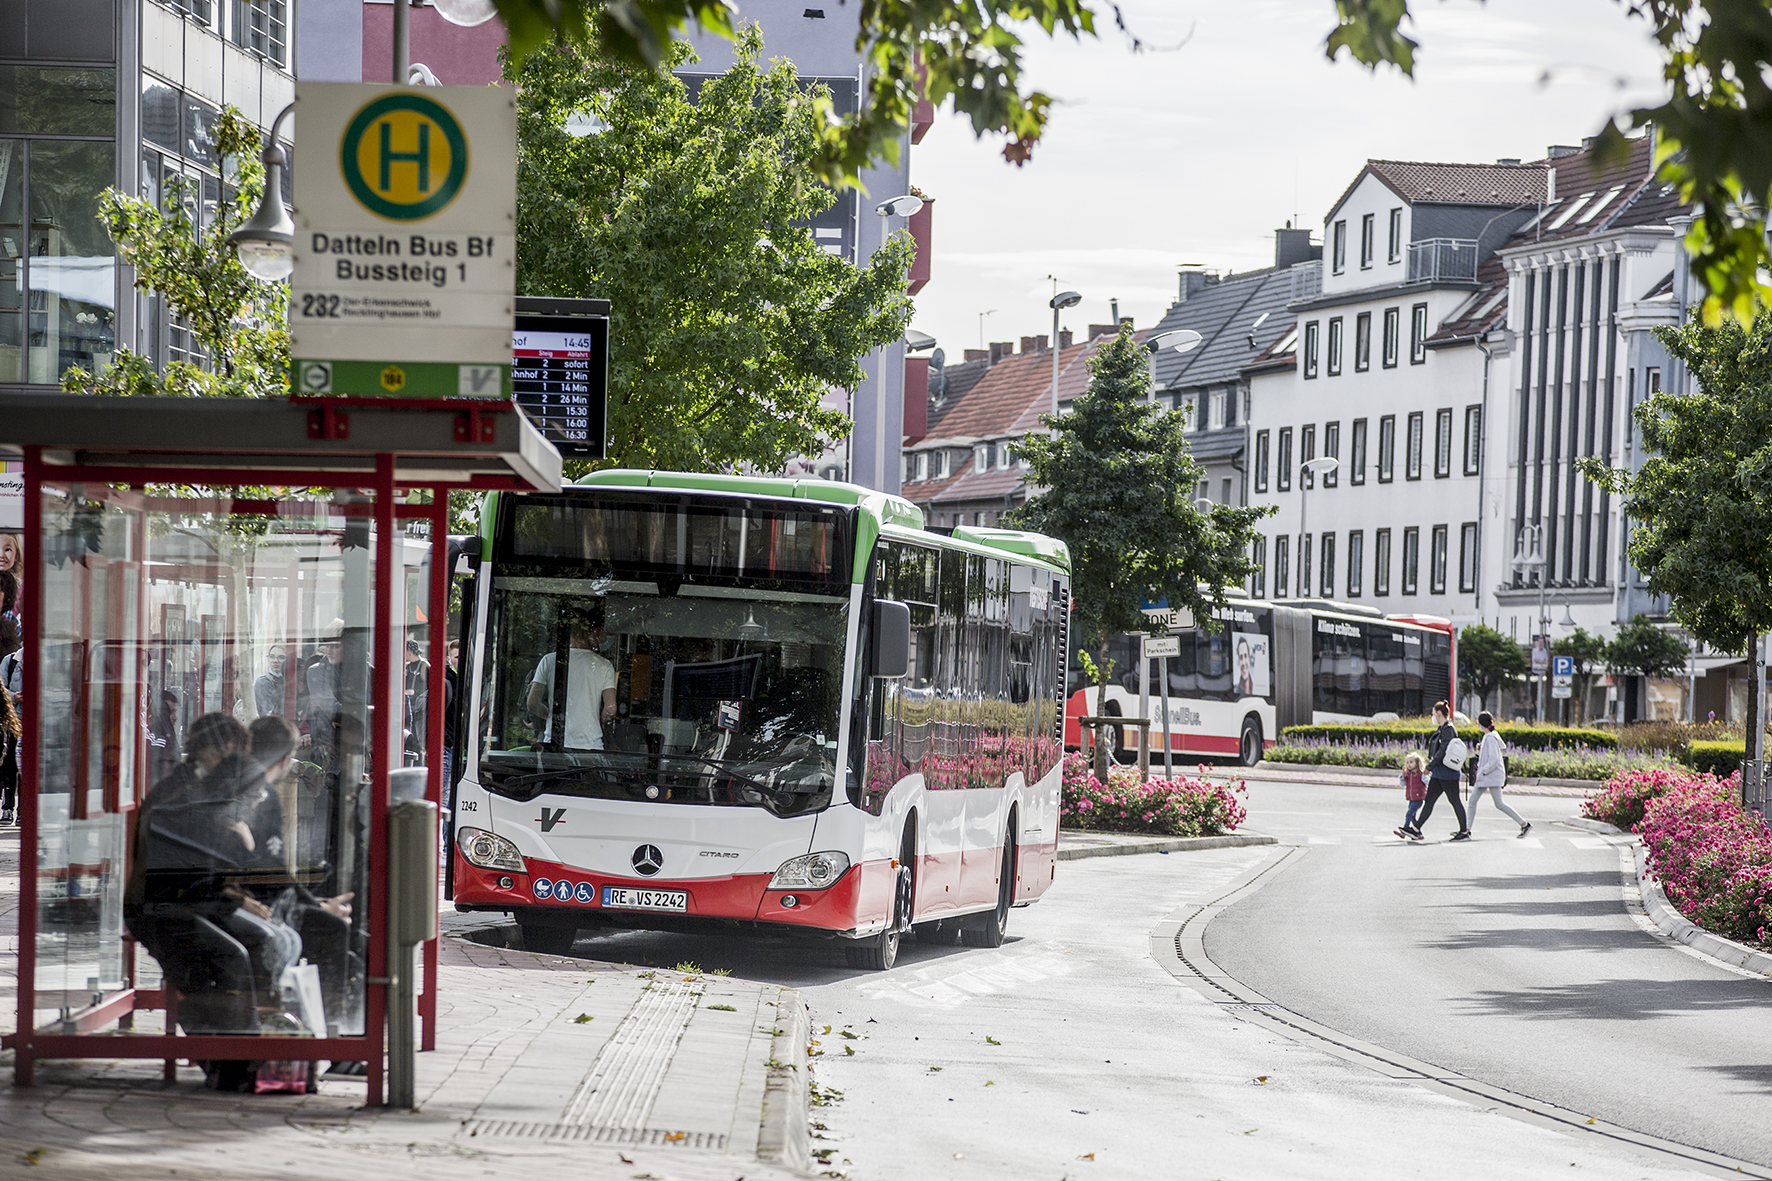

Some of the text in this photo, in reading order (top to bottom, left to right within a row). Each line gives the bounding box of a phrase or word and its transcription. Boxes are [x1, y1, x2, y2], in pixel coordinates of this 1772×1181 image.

[379, 121, 430, 193] H
[312, 233, 495, 257] Datteln Bus Bf
[336, 259, 466, 287] Bussteig 1
[302, 293, 341, 318] 232
[564, 337, 590, 348] 14:45
[543, 358, 549, 367] 2
[564, 360, 588, 369] sofort
[543, 370, 549, 379] 2
[565, 371, 571, 380] 2
[573, 371, 588, 380] Min
[543, 382, 588, 392] 1 14 Min
[542, 394, 548, 403] 2
[560, 395, 571, 404] 26
[572, 395, 587, 404] Min
[543, 406, 588, 416] 1 15:30
[542, 418, 588, 428] 1 16:00
[566, 430, 587, 440] 16:30
[1150, 613, 1178, 626] ONE
[1557, 658, 1569, 674] P
[1154, 705, 1201, 726] SnellBus.
[461, 801, 477, 812] 2242
[612, 890, 685, 908] RE VS 2242
